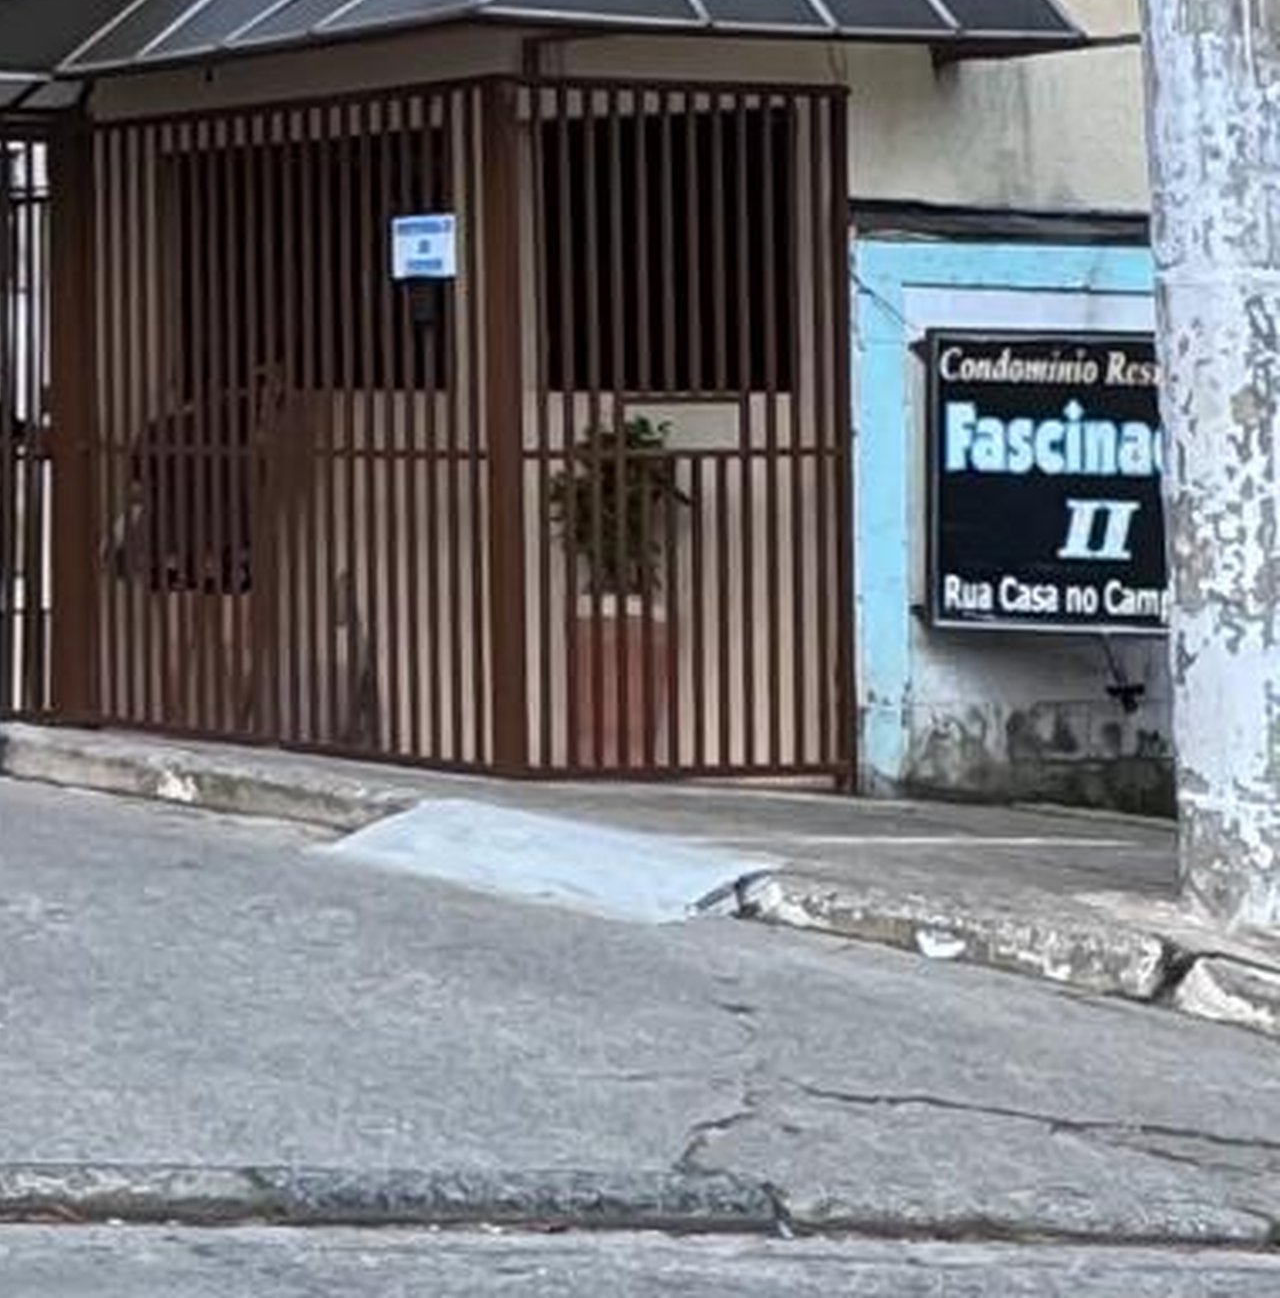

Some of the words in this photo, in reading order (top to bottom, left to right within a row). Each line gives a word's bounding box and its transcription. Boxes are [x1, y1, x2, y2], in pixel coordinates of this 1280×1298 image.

[1057, 499, 1139, 560] II
[944, 574, 993, 610] Rua
[998, 575, 1058, 613] Casa
[1066, 584, 1098, 613] no
